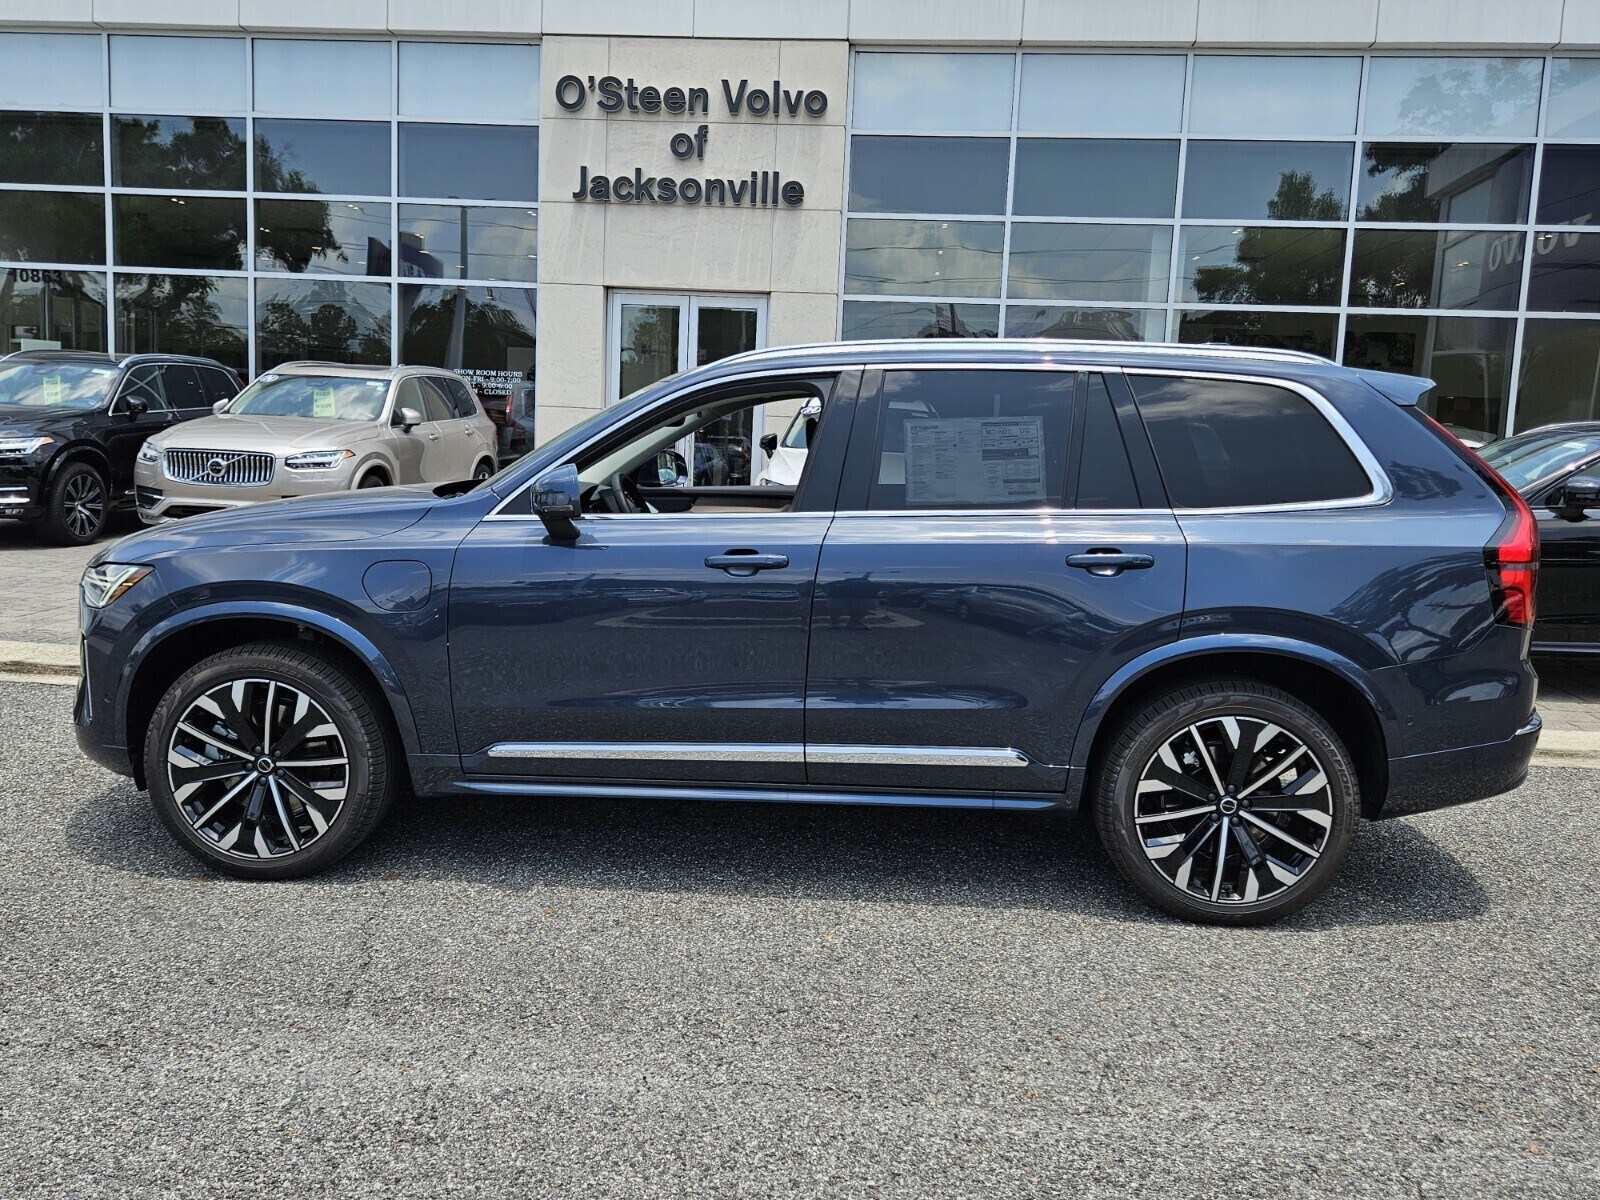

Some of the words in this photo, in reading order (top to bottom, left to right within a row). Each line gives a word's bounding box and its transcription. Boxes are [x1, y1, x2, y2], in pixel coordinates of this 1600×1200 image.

[555, 75, 709, 114] O'Steen
[721, 79, 828, 117] Volvo
[669, 125, 708, 160] of
[572, 166, 805, 207] Jacksonville
[10, 268, 62, 284] 10863
